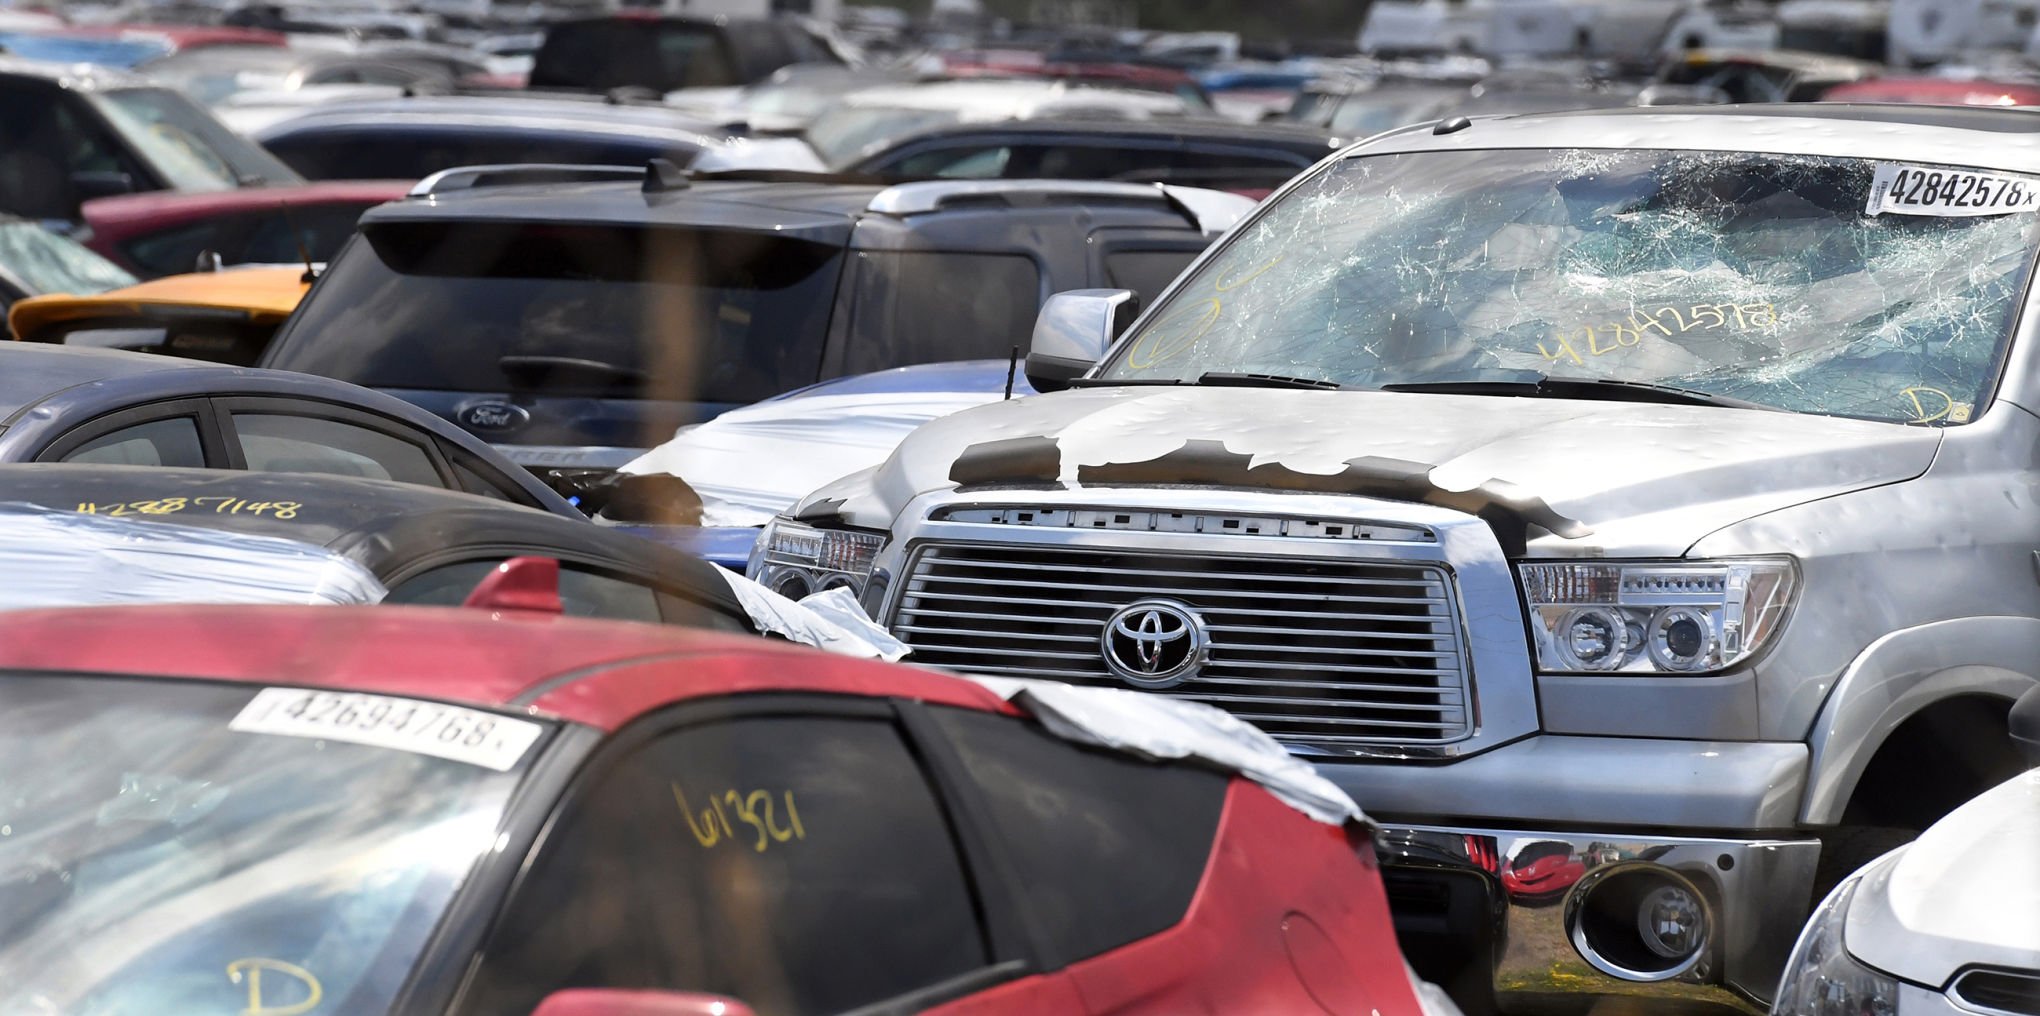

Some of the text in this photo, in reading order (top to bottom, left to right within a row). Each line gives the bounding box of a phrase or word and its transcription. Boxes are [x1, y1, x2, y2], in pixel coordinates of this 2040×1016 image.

[1536, 303, 1776, 365] 42842578
[1900, 386, 1953, 424] D
[672, 781, 806, 852] 61321
[226, 957, 322, 1016] D
